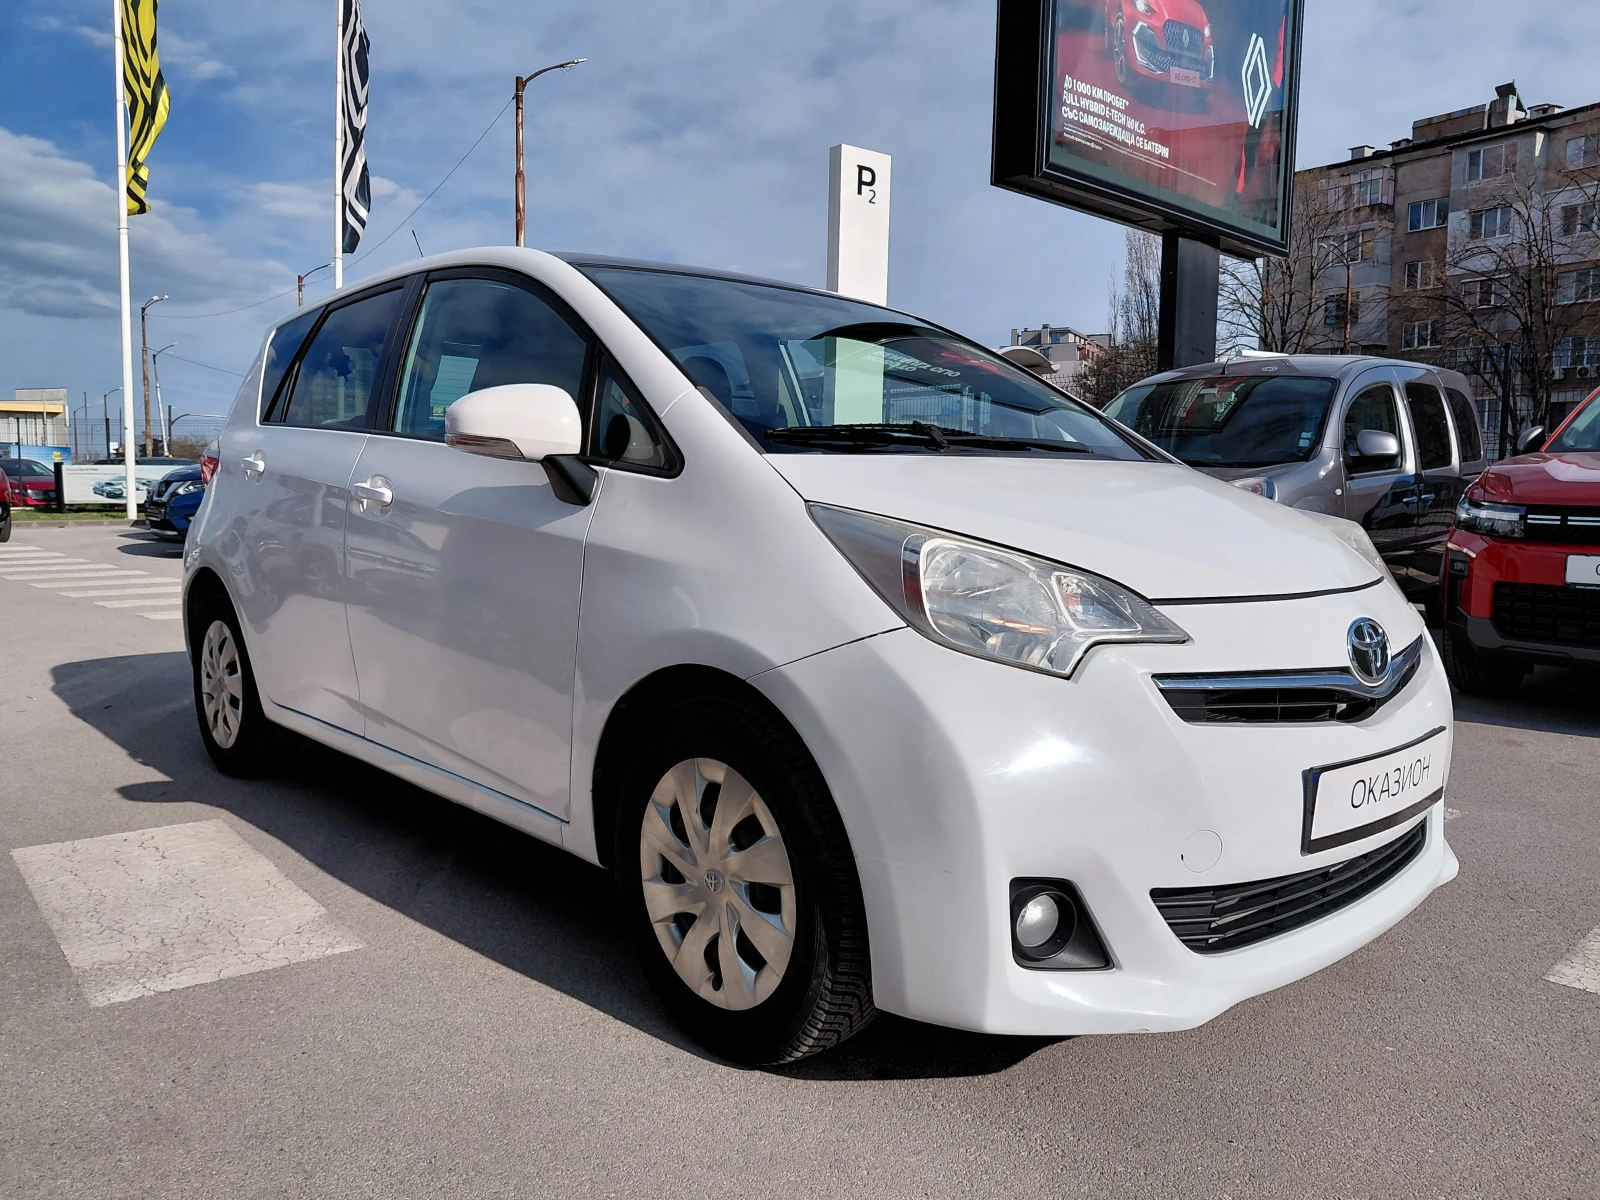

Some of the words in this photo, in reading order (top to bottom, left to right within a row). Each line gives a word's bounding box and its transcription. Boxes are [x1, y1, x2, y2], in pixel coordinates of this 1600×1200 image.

[1064, 74, 1073, 90] ДО
[1063, 90, 1080, 107] FULL
[1080, 97, 1105, 116] HYBRID
[1106, 106, 1126, 126] E-TECH
[1061, 106, 1079, 121] СЪС
[1079, 111, 1136, 147] САМОЗАРЕЖДАЩА
[1135, 135, 1144, 149] СЕ
[1143, 139, 1170, 159] БАТЕРИЯ
[1351, 754, 1431, 809] ОКАЗИОН
